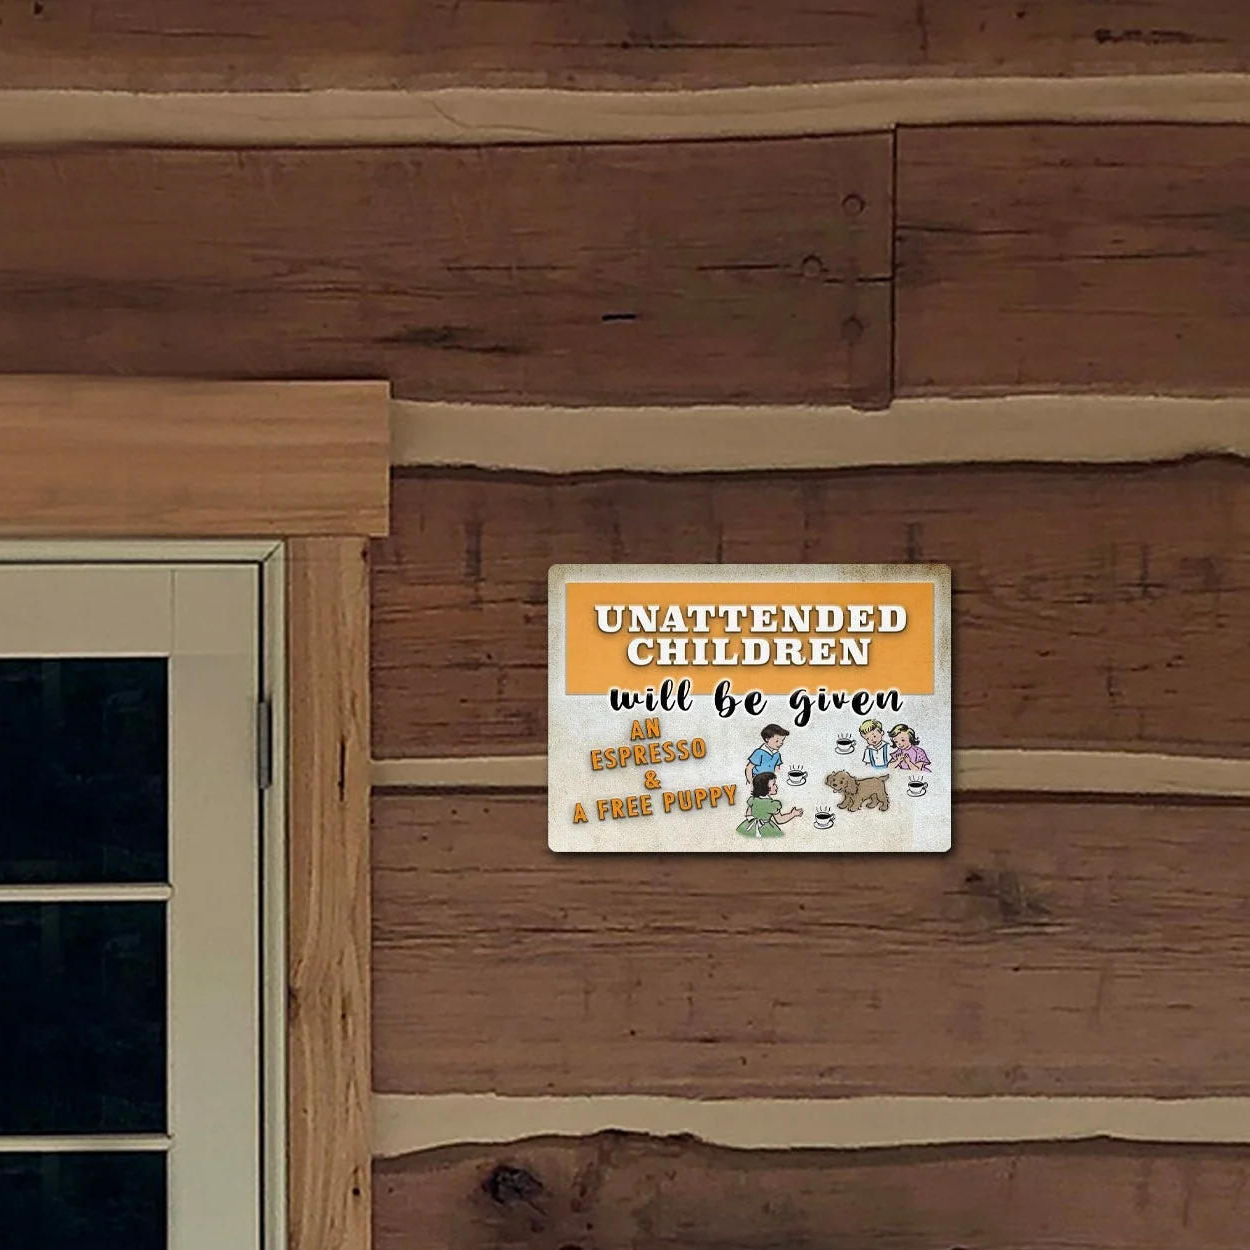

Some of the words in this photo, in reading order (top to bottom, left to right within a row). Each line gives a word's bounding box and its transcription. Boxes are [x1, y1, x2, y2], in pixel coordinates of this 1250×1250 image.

[594, 604, 908, 633] UNATTENDED
[627, 637, 872, 666] CHILDREN
[609, 679, 693, 711] will
[714, 679, 767, 718] be
[789, 683, 905, 727] given
[630, 716, 661, 741] AN
[590, 737, 707, 772] ESPRESSO
[644, 769, 661, 790] &
[573, 802, 589, 824] A
[597, 794, 653, 821] FREE
[662, 784, 737, 813] PUPPY
